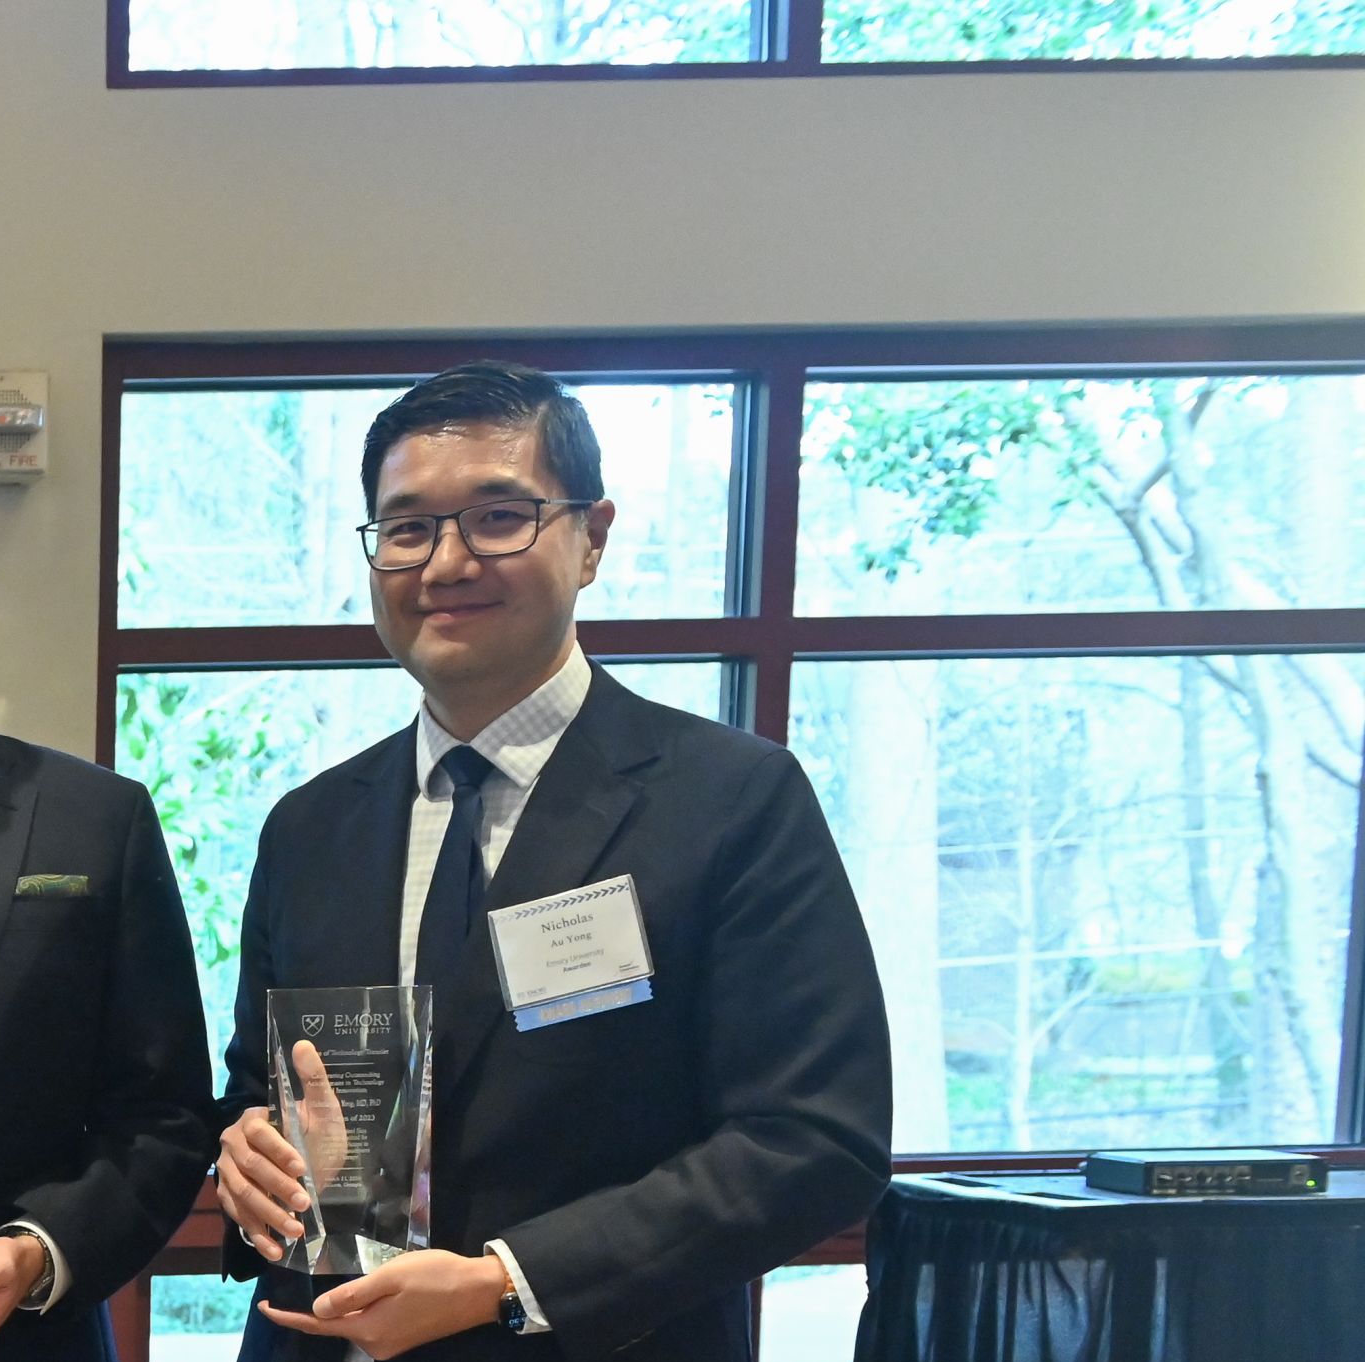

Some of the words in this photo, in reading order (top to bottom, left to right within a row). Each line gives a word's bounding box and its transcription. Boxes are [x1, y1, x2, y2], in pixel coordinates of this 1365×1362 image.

[9, 454, 37, 466] FIRE
[540, 913, 594, 933] Nicholas
[551, 939, 564, 948] Au
[566, 932, 592, 943] Yong
[333, 1013, 393, 1027] EMORY
[334, 1027, 391, 1035] UNIVSITY
